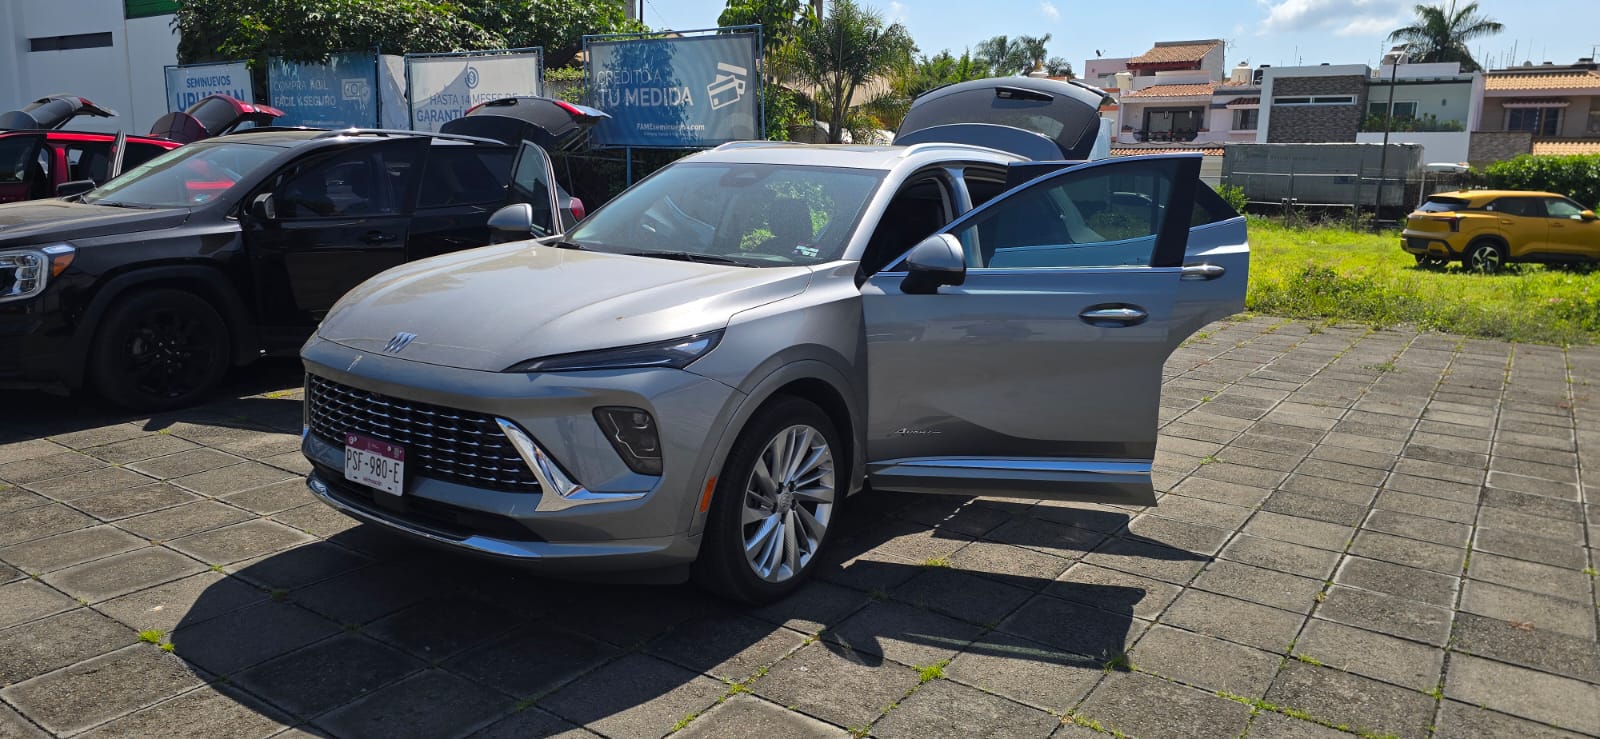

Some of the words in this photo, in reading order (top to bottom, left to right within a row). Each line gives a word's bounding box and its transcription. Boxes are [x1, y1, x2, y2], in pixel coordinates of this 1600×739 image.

[186, 75, 231, 88] SEMINUEVOS
[303, 95, 336, 107] SEGURO
[430, 93, 459, 106] HASTA
[598, 88, 620, 107] TU
[625, 86, 694, 107] MEDIDA
[416, 106, 463, 122] GARANTÍ
[346, 448, 400, 484] PSF-980-E
